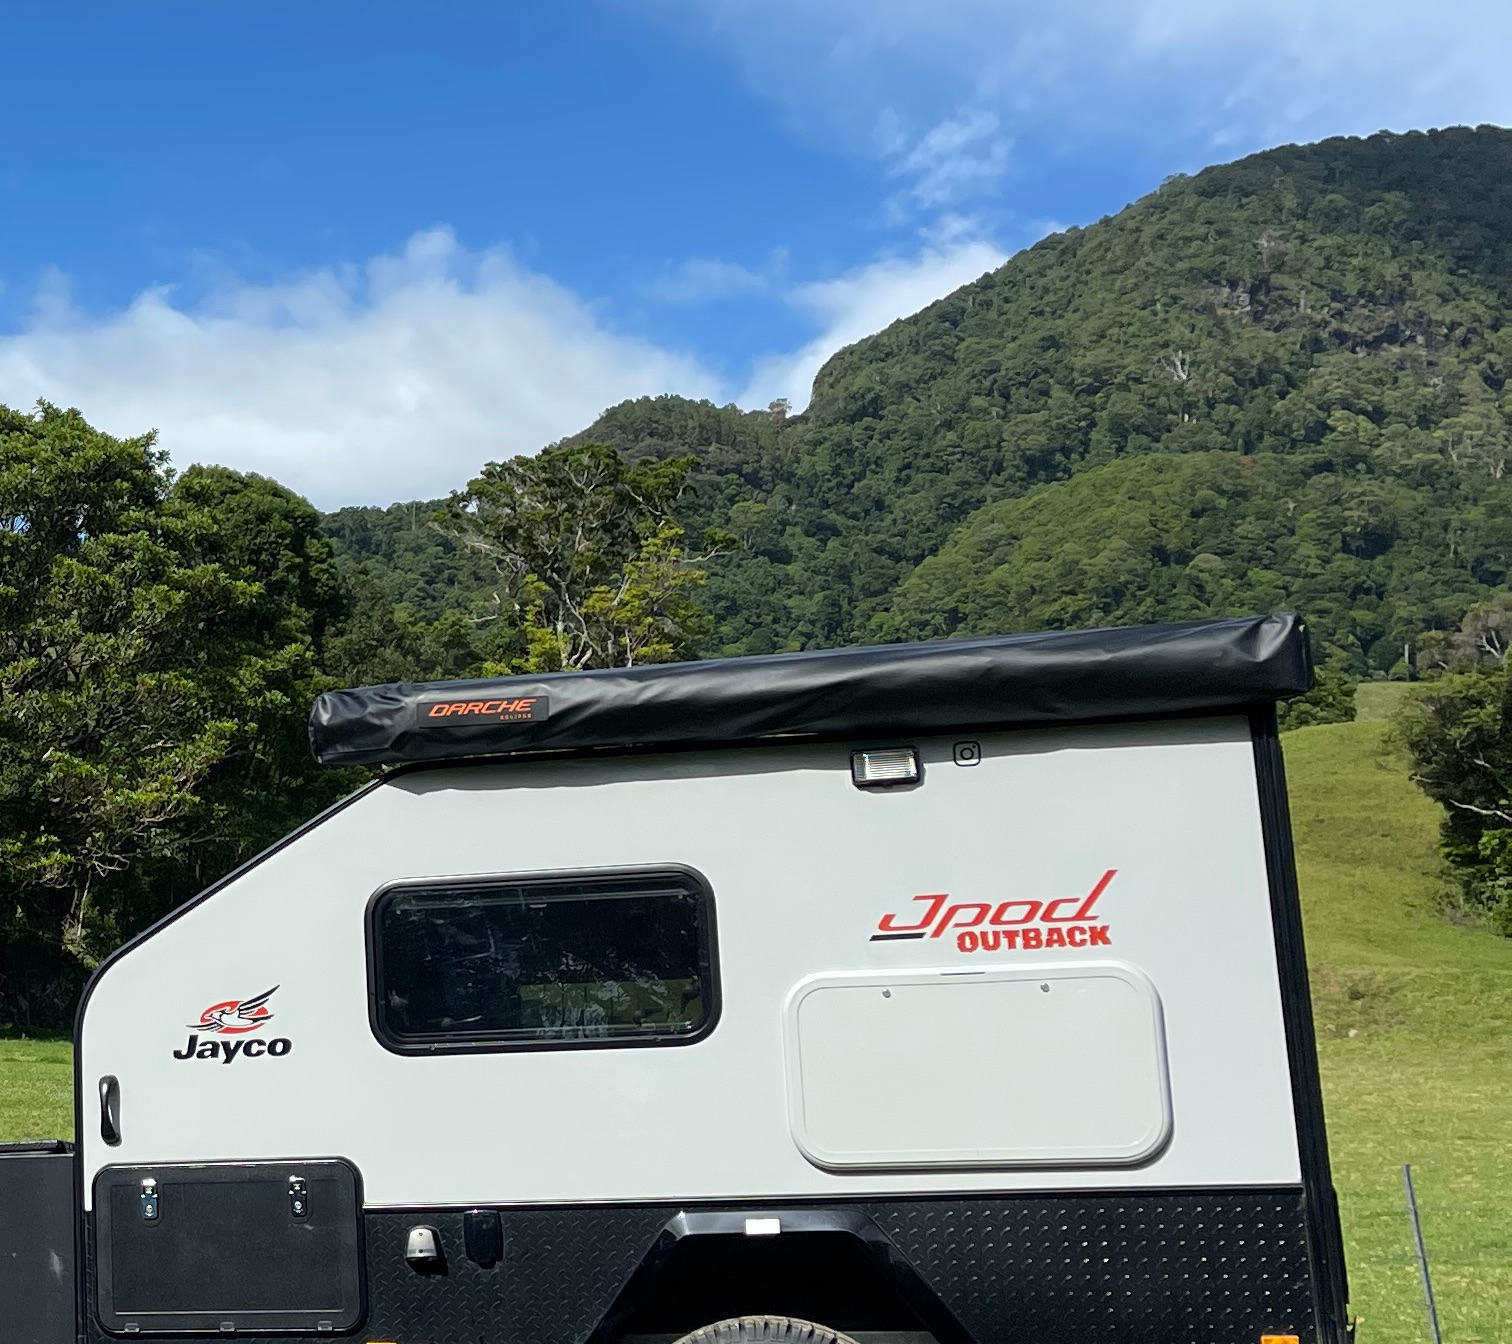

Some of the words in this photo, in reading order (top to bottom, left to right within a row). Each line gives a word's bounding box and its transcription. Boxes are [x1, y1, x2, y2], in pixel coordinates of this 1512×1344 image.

[429, 698, 537, 717] DARCHE
[878, 869, 1118, 938] Jpod
[956, 925, 1112, 952] OUTBACK
[173, 1034, 292, 1064] Jayco
